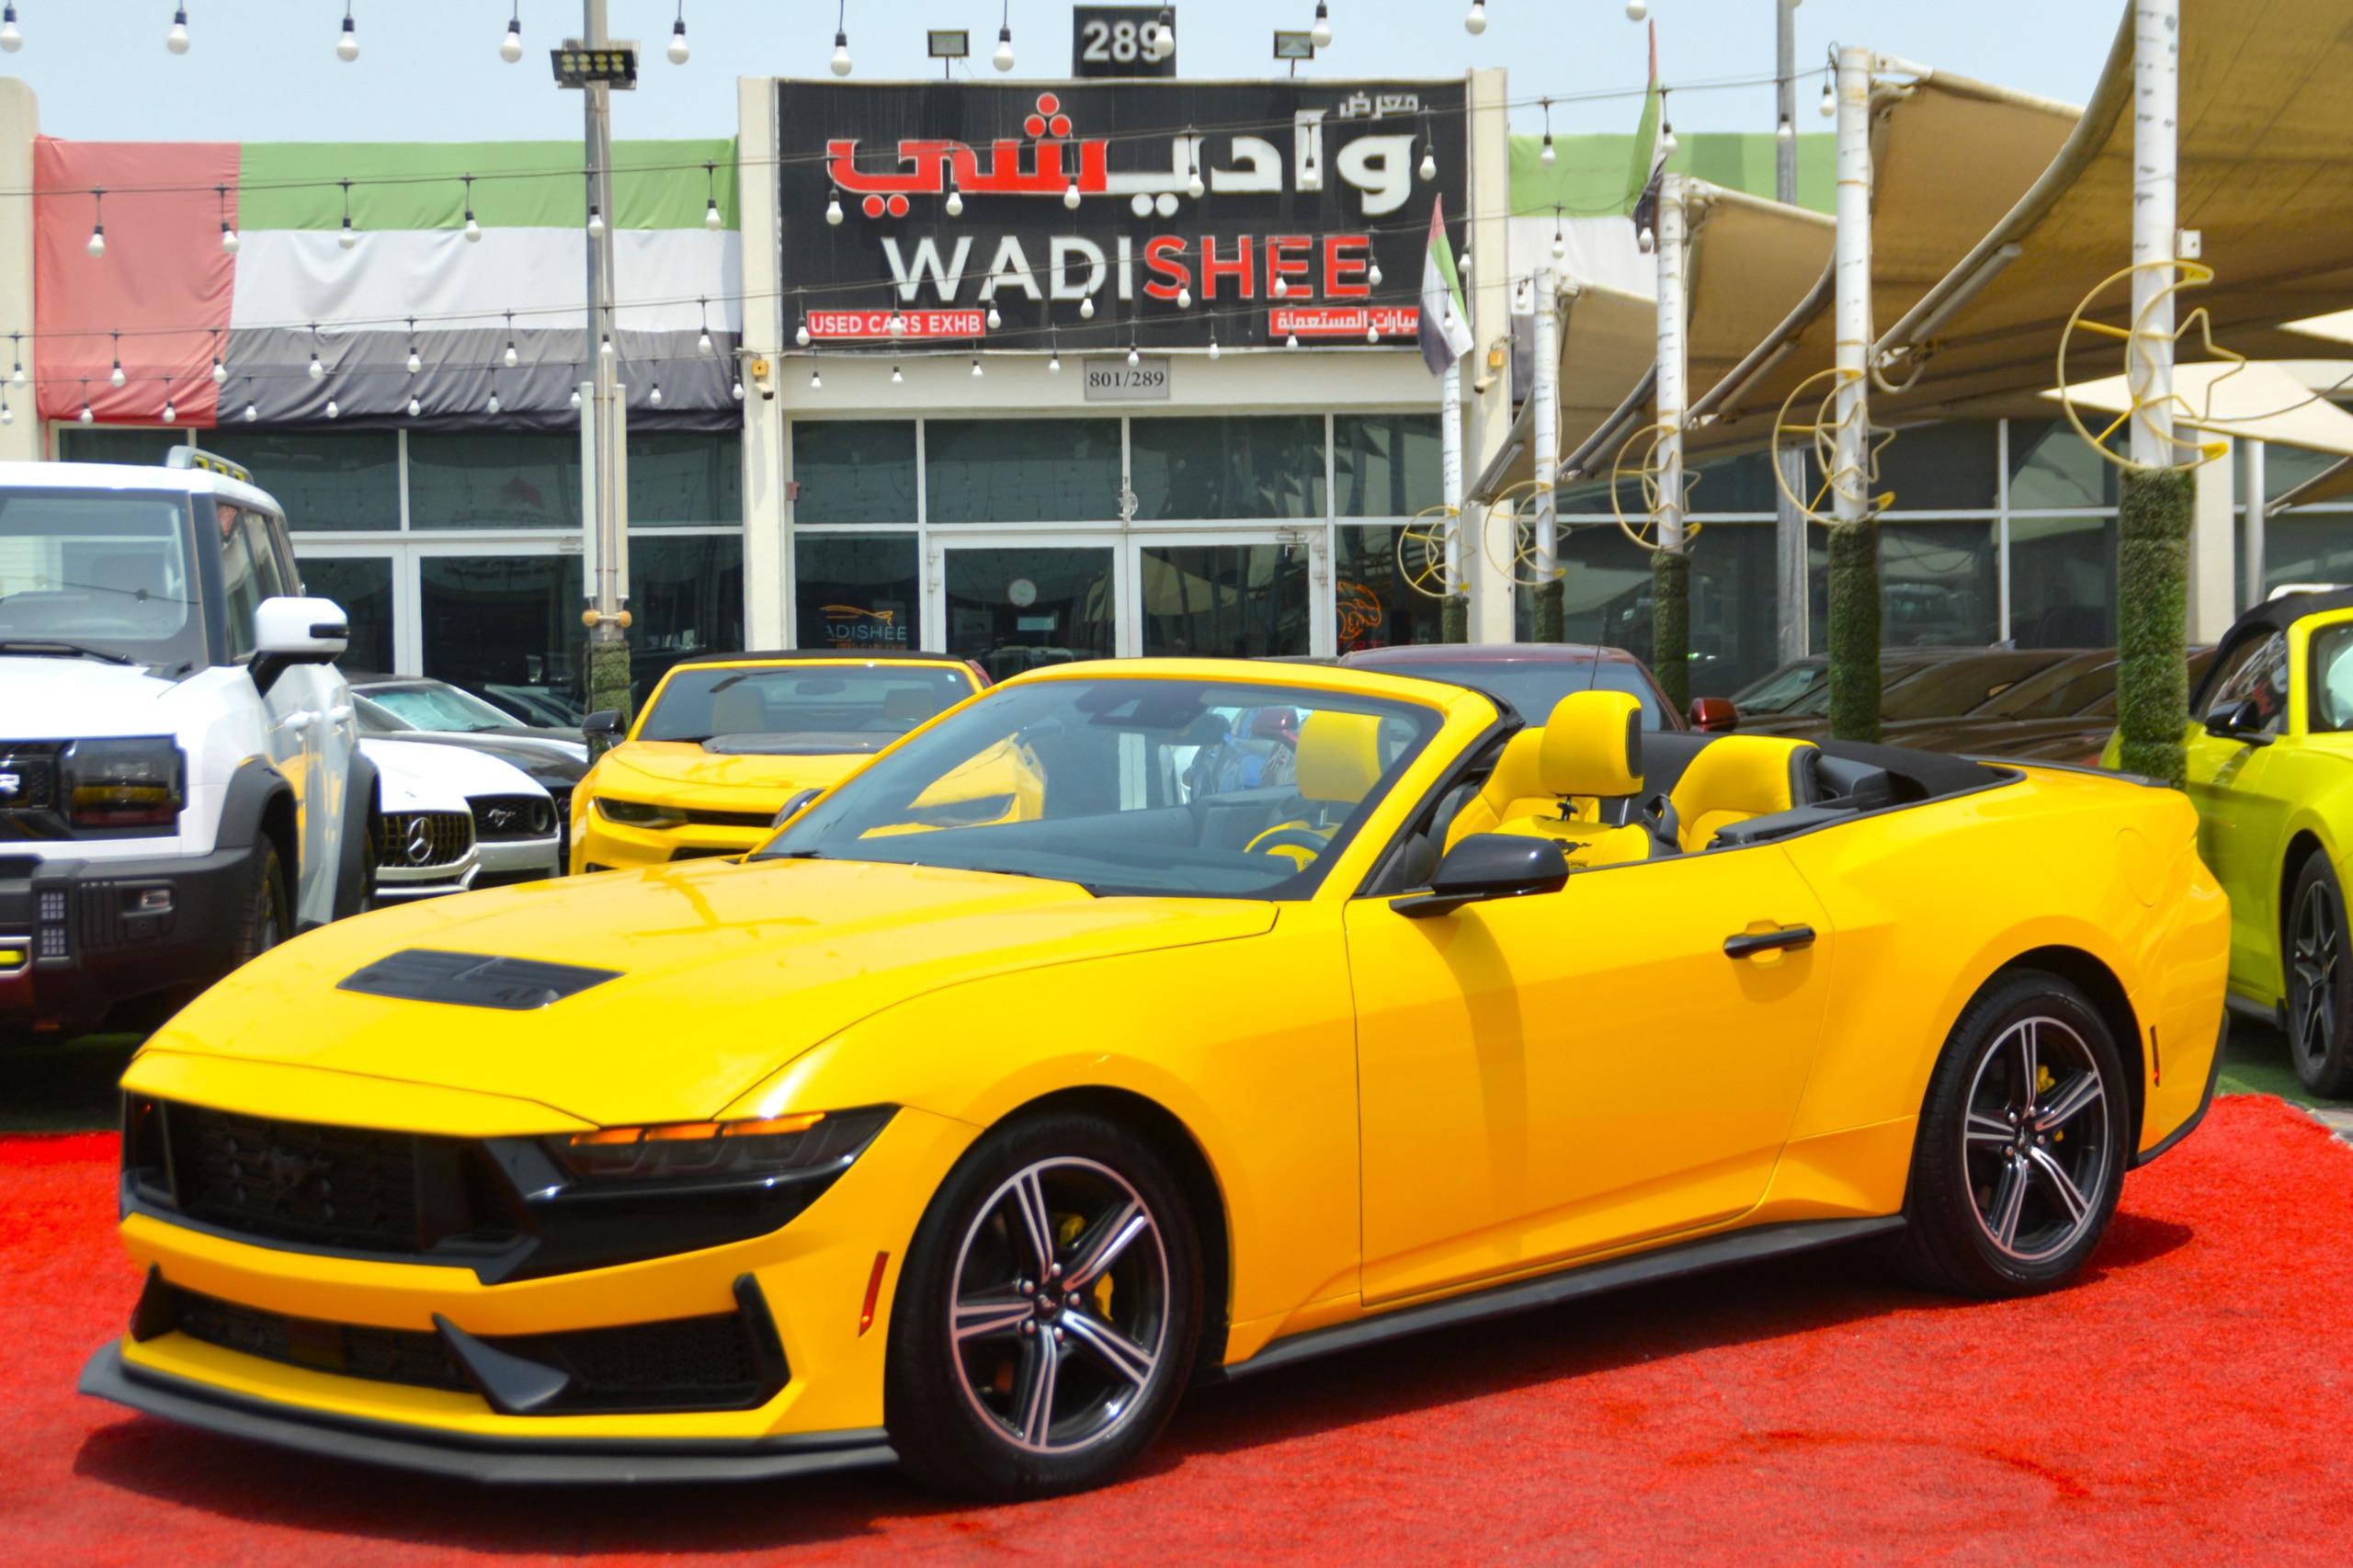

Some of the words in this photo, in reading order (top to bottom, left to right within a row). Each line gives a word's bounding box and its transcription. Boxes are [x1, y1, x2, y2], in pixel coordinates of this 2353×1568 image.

[1083, 20, 1165, 62] 289
[1339, 90, 1418, 119] معرض
[880, 234, 1371, 301] WADISHEE
[811, 315, 862, 333] USED
[868, 315, 921, 333] CARS
[928, 314, 980, 332] EXHB
[1277, 310, 1368, 330] المستعملة
[1089, 370, 1165, 388] 801/289
